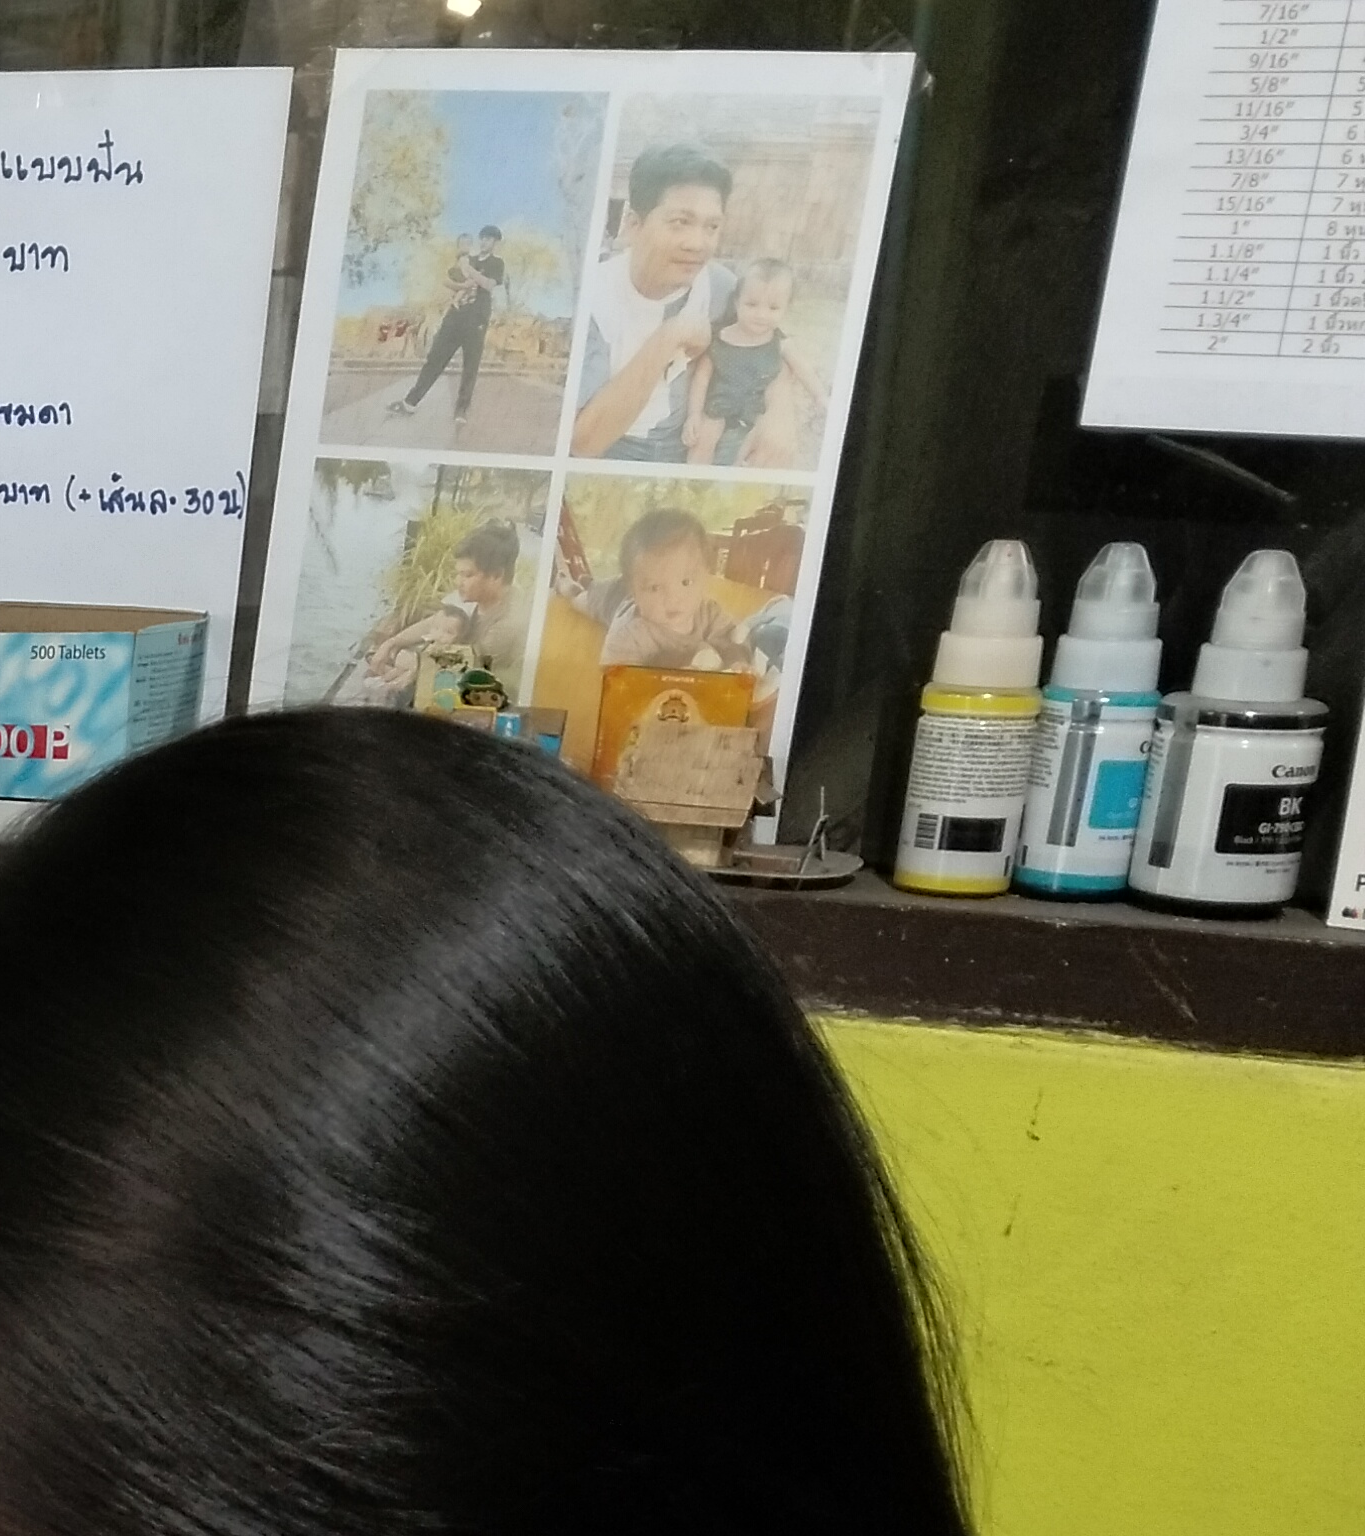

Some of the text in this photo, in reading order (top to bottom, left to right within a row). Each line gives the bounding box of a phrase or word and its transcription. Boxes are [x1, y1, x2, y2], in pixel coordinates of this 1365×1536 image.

[1326, 221, 1338, 236] 8
[3, 242, 69, 272] บาท
[1302, 338, 1314, 353] 2
[30, 643, 106, 662] 500 Tablets
[47, 723, 71, 760] P
[1278, 797, 1304, 816] BK
